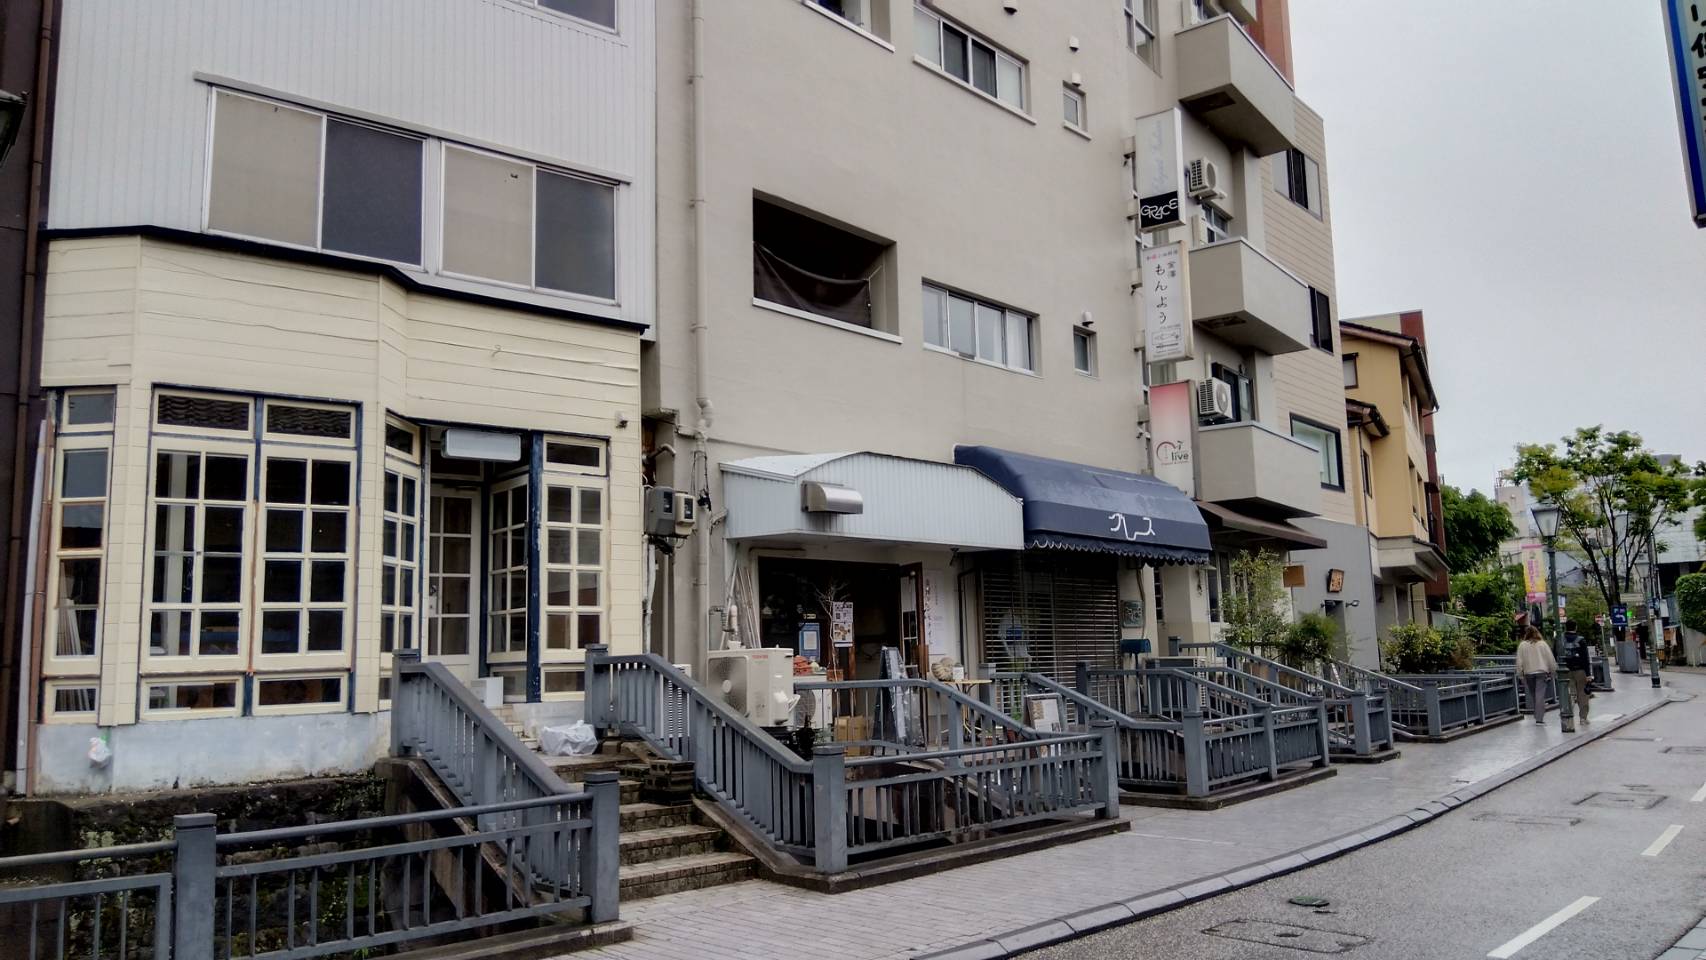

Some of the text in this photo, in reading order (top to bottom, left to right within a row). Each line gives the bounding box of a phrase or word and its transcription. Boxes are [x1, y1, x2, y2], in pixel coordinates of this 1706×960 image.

[1140, 197, 1179, 219] GRACE
[1155, 263, 1168, 324] もんよう
